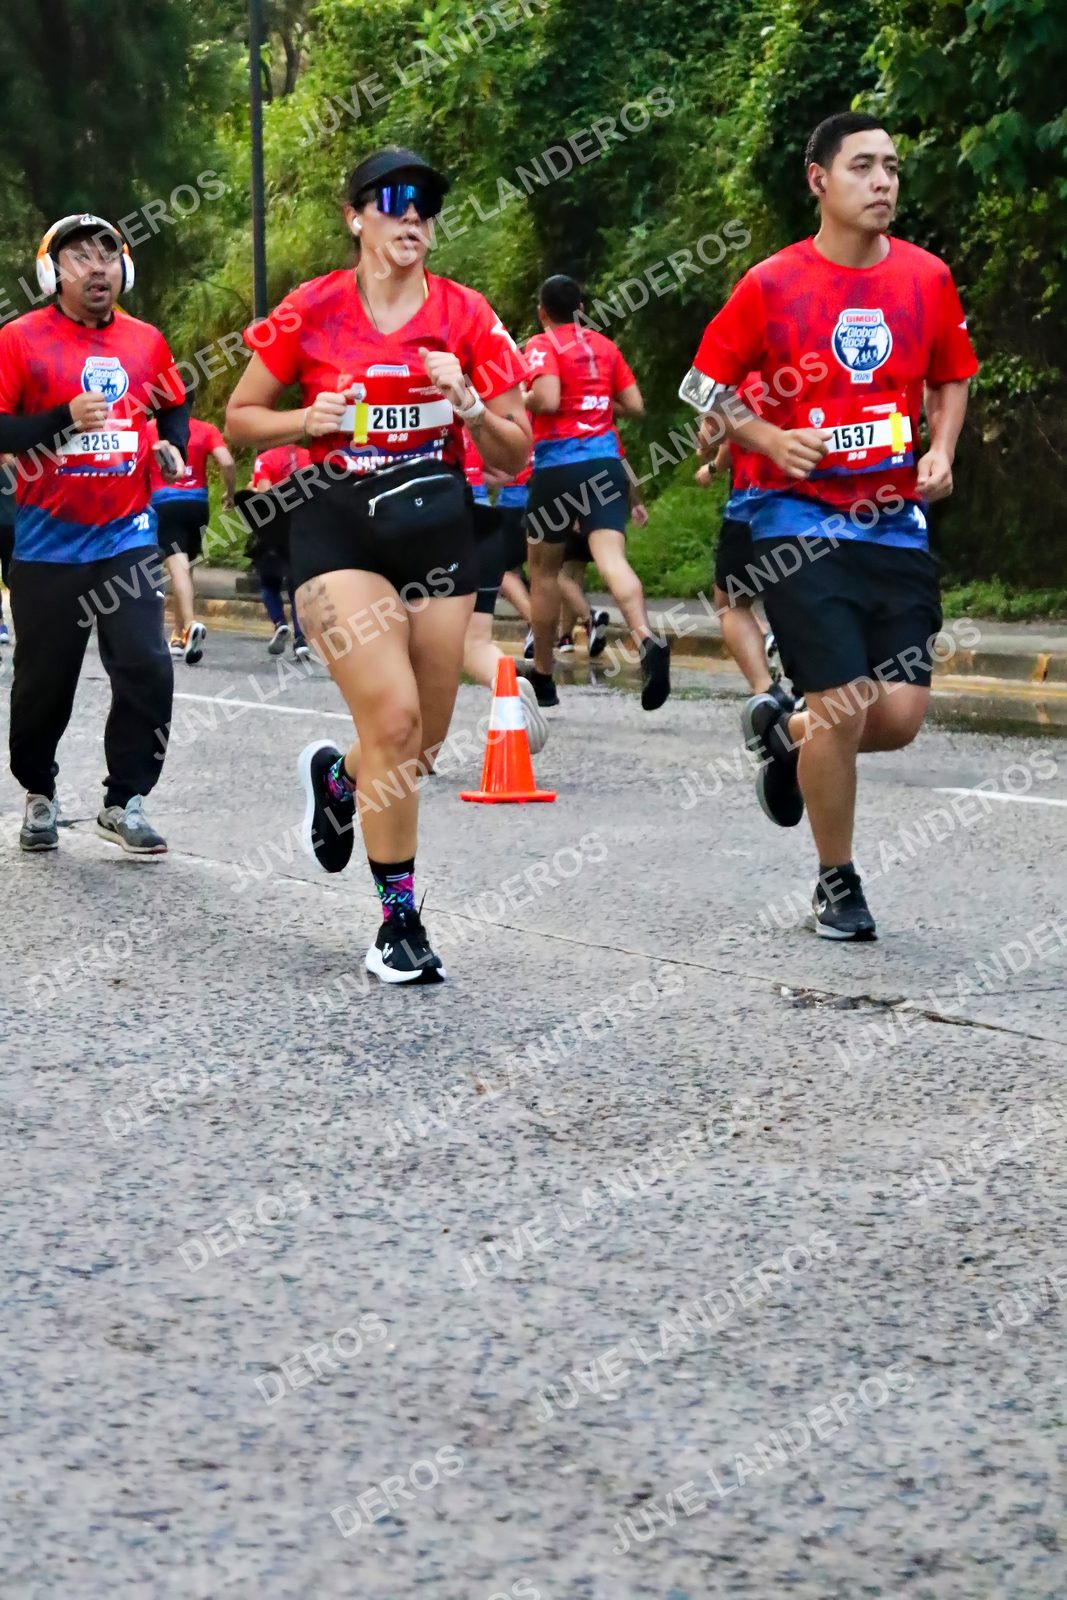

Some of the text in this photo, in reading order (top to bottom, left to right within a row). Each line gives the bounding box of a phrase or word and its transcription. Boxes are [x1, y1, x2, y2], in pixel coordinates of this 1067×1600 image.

[847, 326, 877, 338] Global
[841, 336, 866, 348] Race
[372, 405, 421, 430] 2613
[81, 433, 120, 452] 3255
[832, 423, 875, 451] 1537
